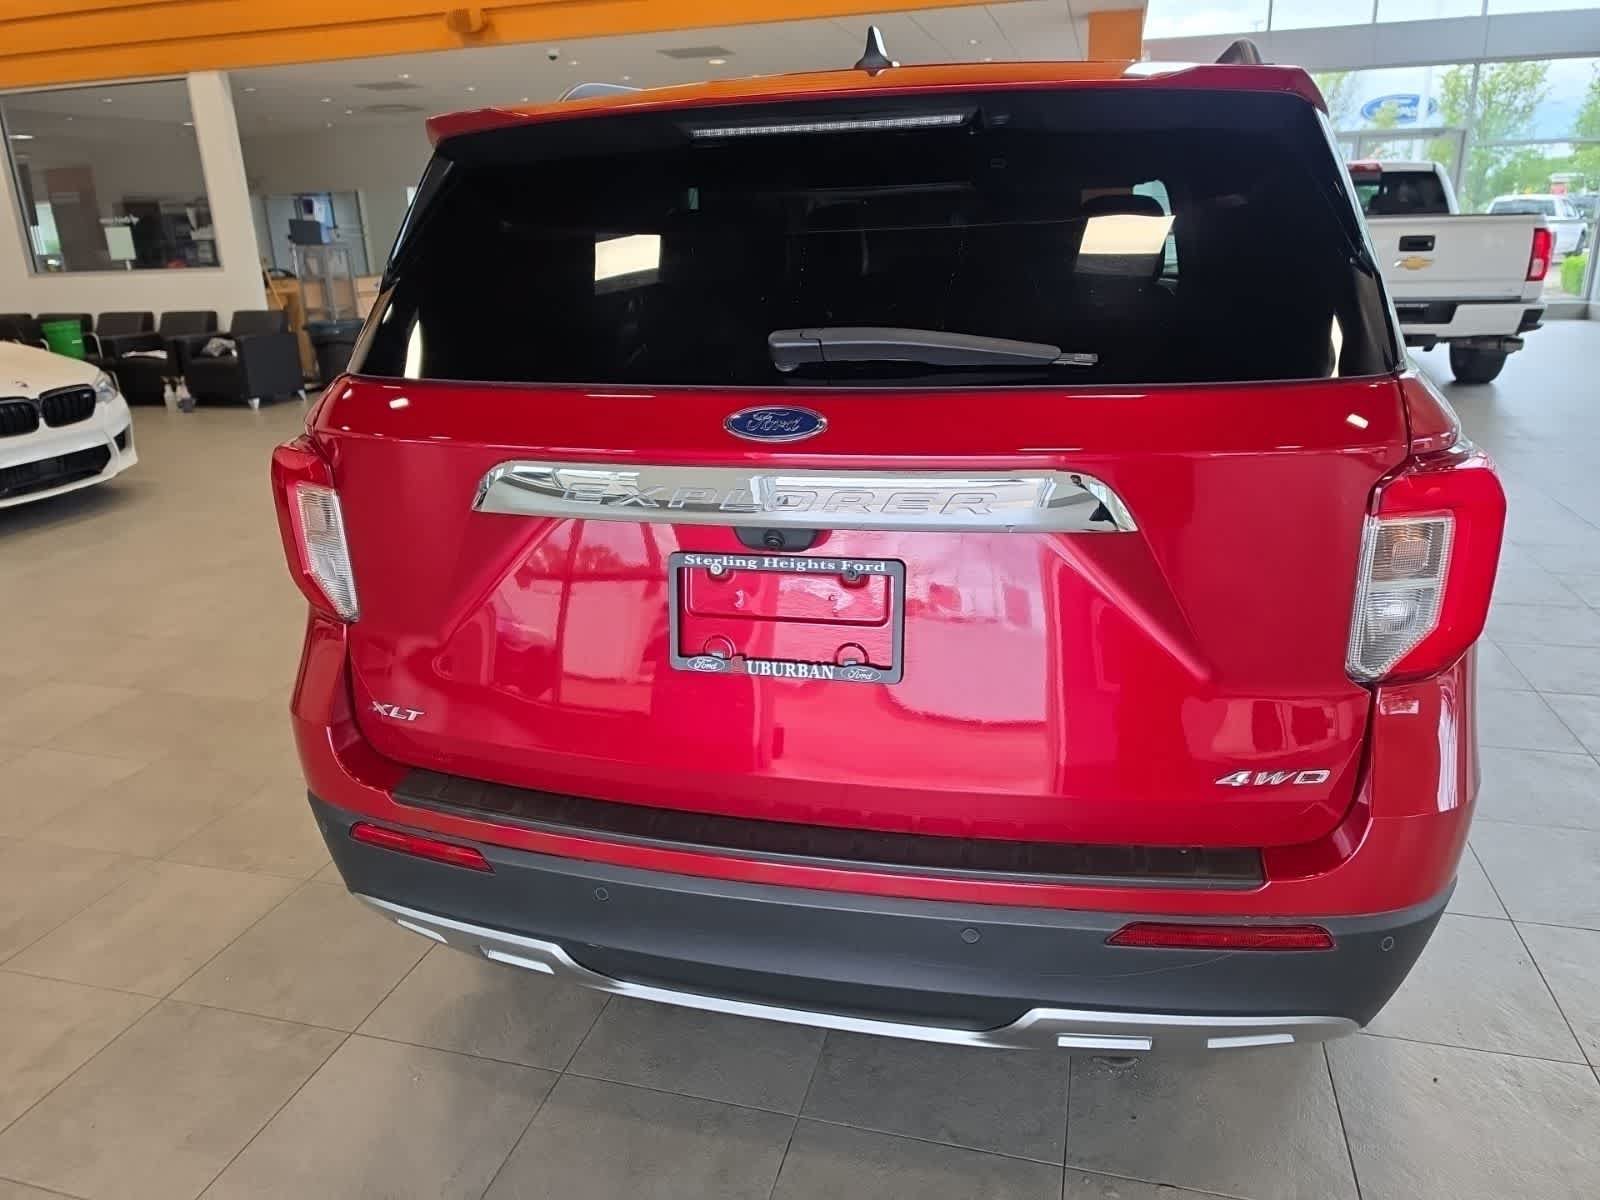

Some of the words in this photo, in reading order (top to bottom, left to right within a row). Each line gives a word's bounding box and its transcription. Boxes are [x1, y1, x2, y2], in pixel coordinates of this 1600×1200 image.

[744, 410, 803, 433] Ford
[562, 483, 998, 515] EXPLORER
[684, 554, 758, 570] Sterling
[763, 557, 836, 572] Heights
[840, 560, 886, 573] Ford
[369, 700, 425, 721] XLT
[1215, 769, 1331, 787] 4WD
